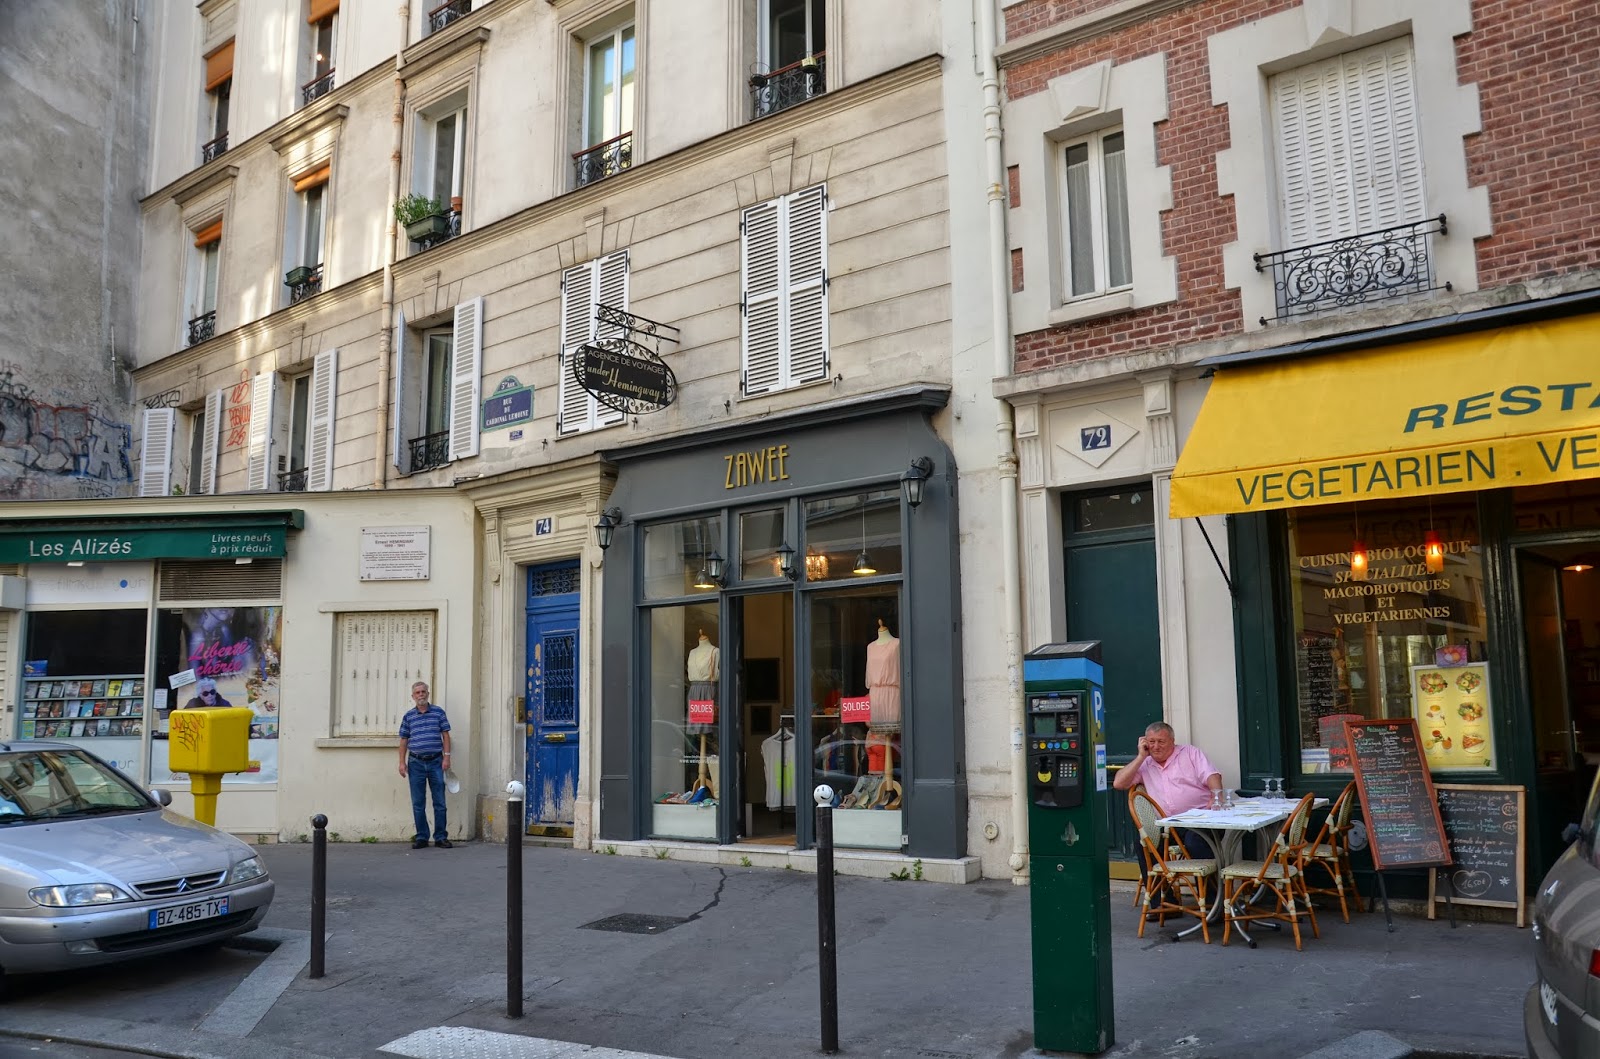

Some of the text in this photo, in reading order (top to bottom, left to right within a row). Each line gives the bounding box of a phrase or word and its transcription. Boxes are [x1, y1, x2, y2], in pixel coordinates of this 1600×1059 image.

[587, 360, 611, 377] under
[588, 349, 665, 375] AGENCE DE VOYAGES
[503, 397, 513, 406] RUE
[503, 405, 511, 414] DU
[485, 409, 529, 426] CARDINAL LEMOINE
[1084, 427, 1108, 449] 72
[724, 444, 789, 489] ZAWEE
[1236, 447, 1495, 505] VEGETARIEN
[537, 518, 550, 535] 74
[211, 533, 272, 543] Livres neufs
[30, 538, 132, 557] Les Alizés
[211, 543, 273, 555] à prix réduit
[1335, 562, 1436, 584] SPCIALITÉS
[1324, 578, 1451, 600] MACROBIOTIQUES
[1377, 596, 1396, 609] ET
[1334, 606, 1451, 625] VEGETARIENNES
[188, 641, 249, 662] Liberté
[196, 659, 243, 677] chérie
[690, 704, 713, 713] SOLDES
[842, 701, 870, 712] SOLDES
[1094, 690, 1102, 724] P
